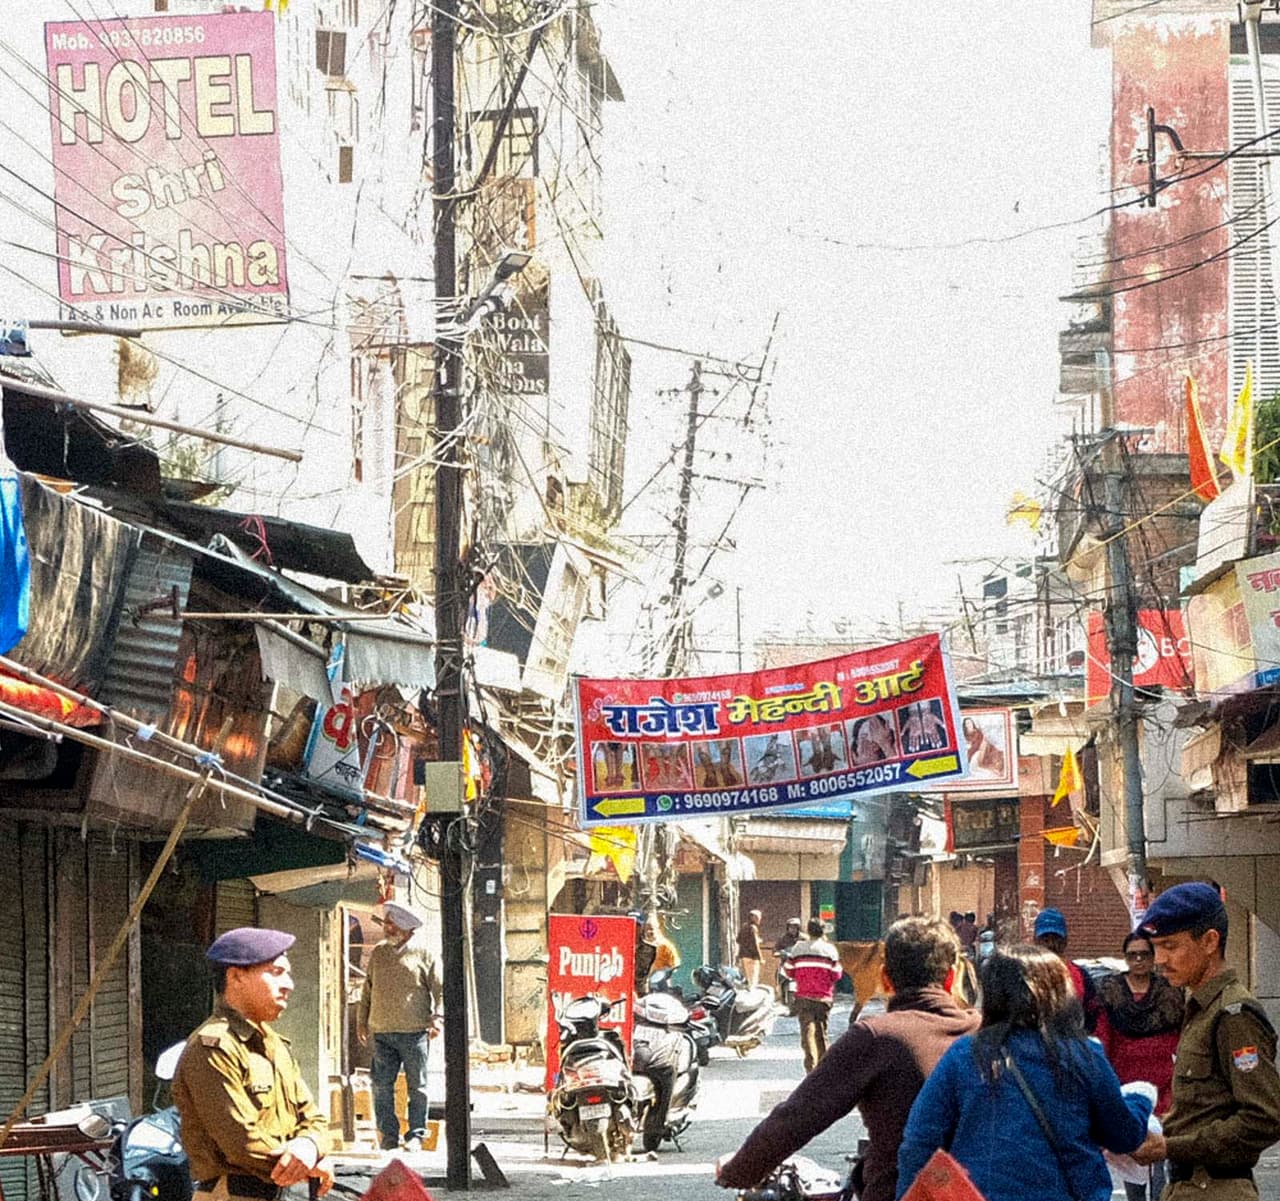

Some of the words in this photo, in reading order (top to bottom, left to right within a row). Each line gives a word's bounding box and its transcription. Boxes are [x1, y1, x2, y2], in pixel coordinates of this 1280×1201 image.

[52, 32, 93, 49] Mob.
[56, 53, 275, 145] HOTEL
[67, 229, 279, 296] Krishna
[110, 304, 137, 320] Non
[173, 300, 213, 316] Room
[602, 696, 720, 735] राजेश
[853, 660, 925, 706] आर्ट
[683, 787, 778, 810] 9690974168
[787, 785, 807, 800] M:
[810, 763, 902, 796] 8006552057
[558, 945, 624, 983] Punjab
